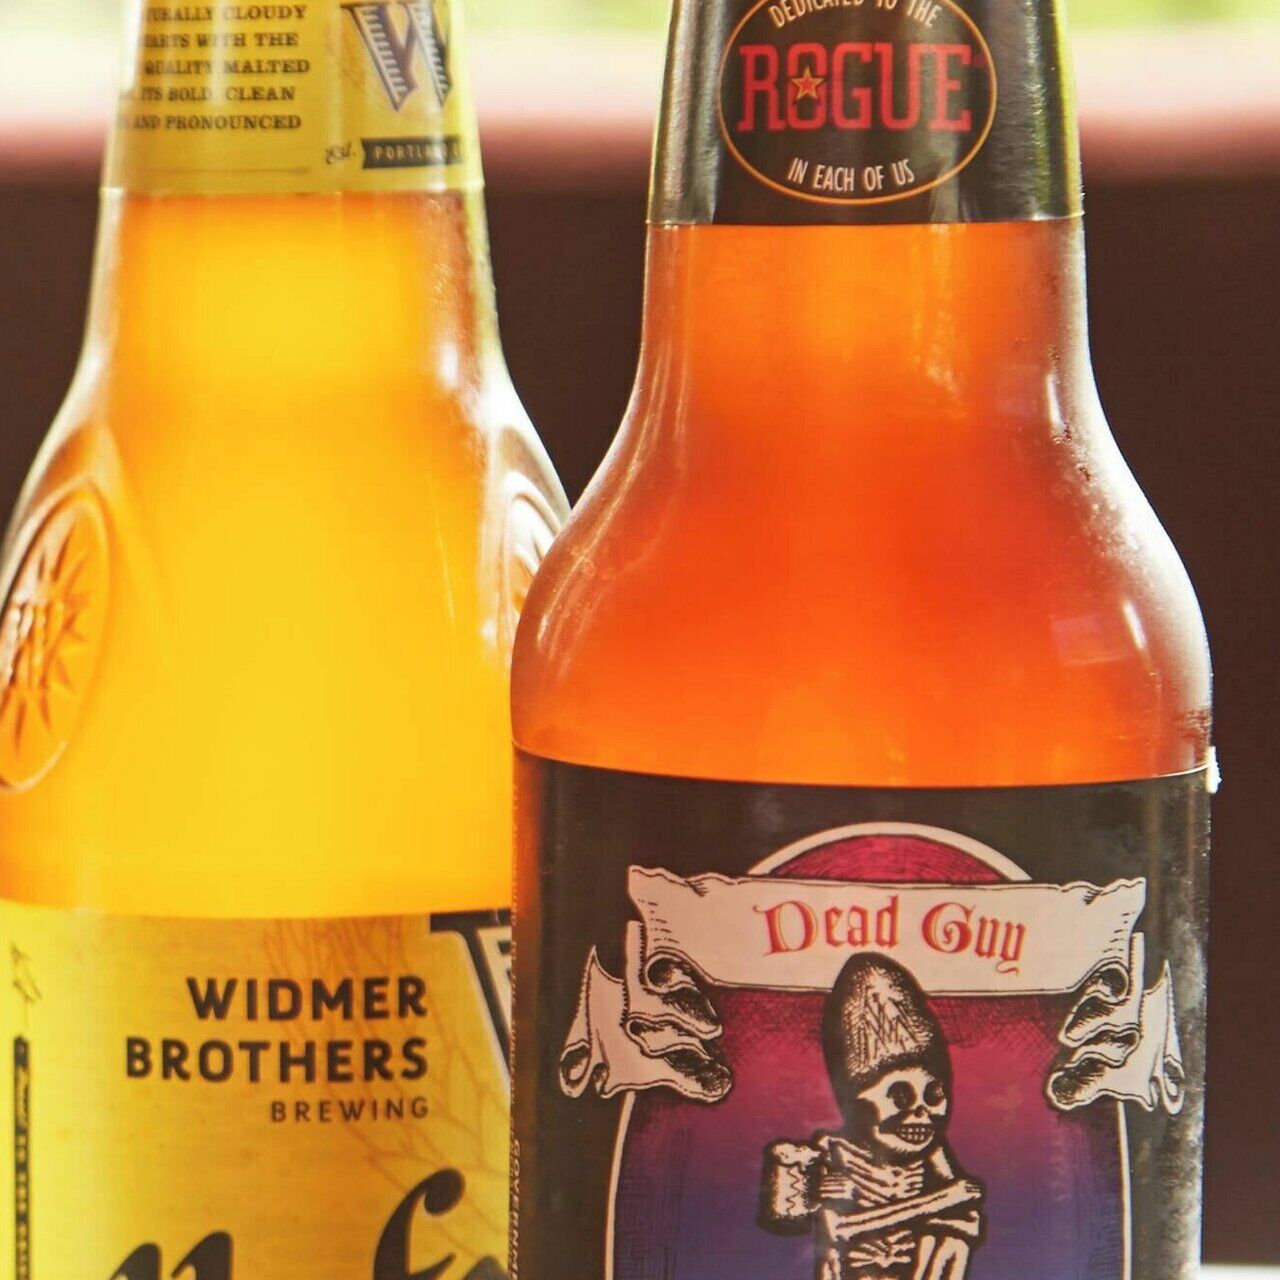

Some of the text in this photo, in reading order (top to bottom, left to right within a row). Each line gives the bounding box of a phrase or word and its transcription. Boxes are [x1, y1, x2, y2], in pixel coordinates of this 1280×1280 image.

[222, 5, 308, 21] CLOUDY
[255, 31, 299, 47] THE
[223, 59, 311, 74] MALTED
[225, 86, 296, 101] CLEAN
[736, 42, 972, 133] ROGUE
[165, 114, 302, 130] PRONOUNCED
[787, 158, 915, 192] IN EACH OF US
[753, 895, 1027, 976] Dead Guy
[186, 975, 428, 1022] WIDMER
[126, 1035, 428, 1084] BROTHERS
[271, 1095, 429, 1124] BREWING
